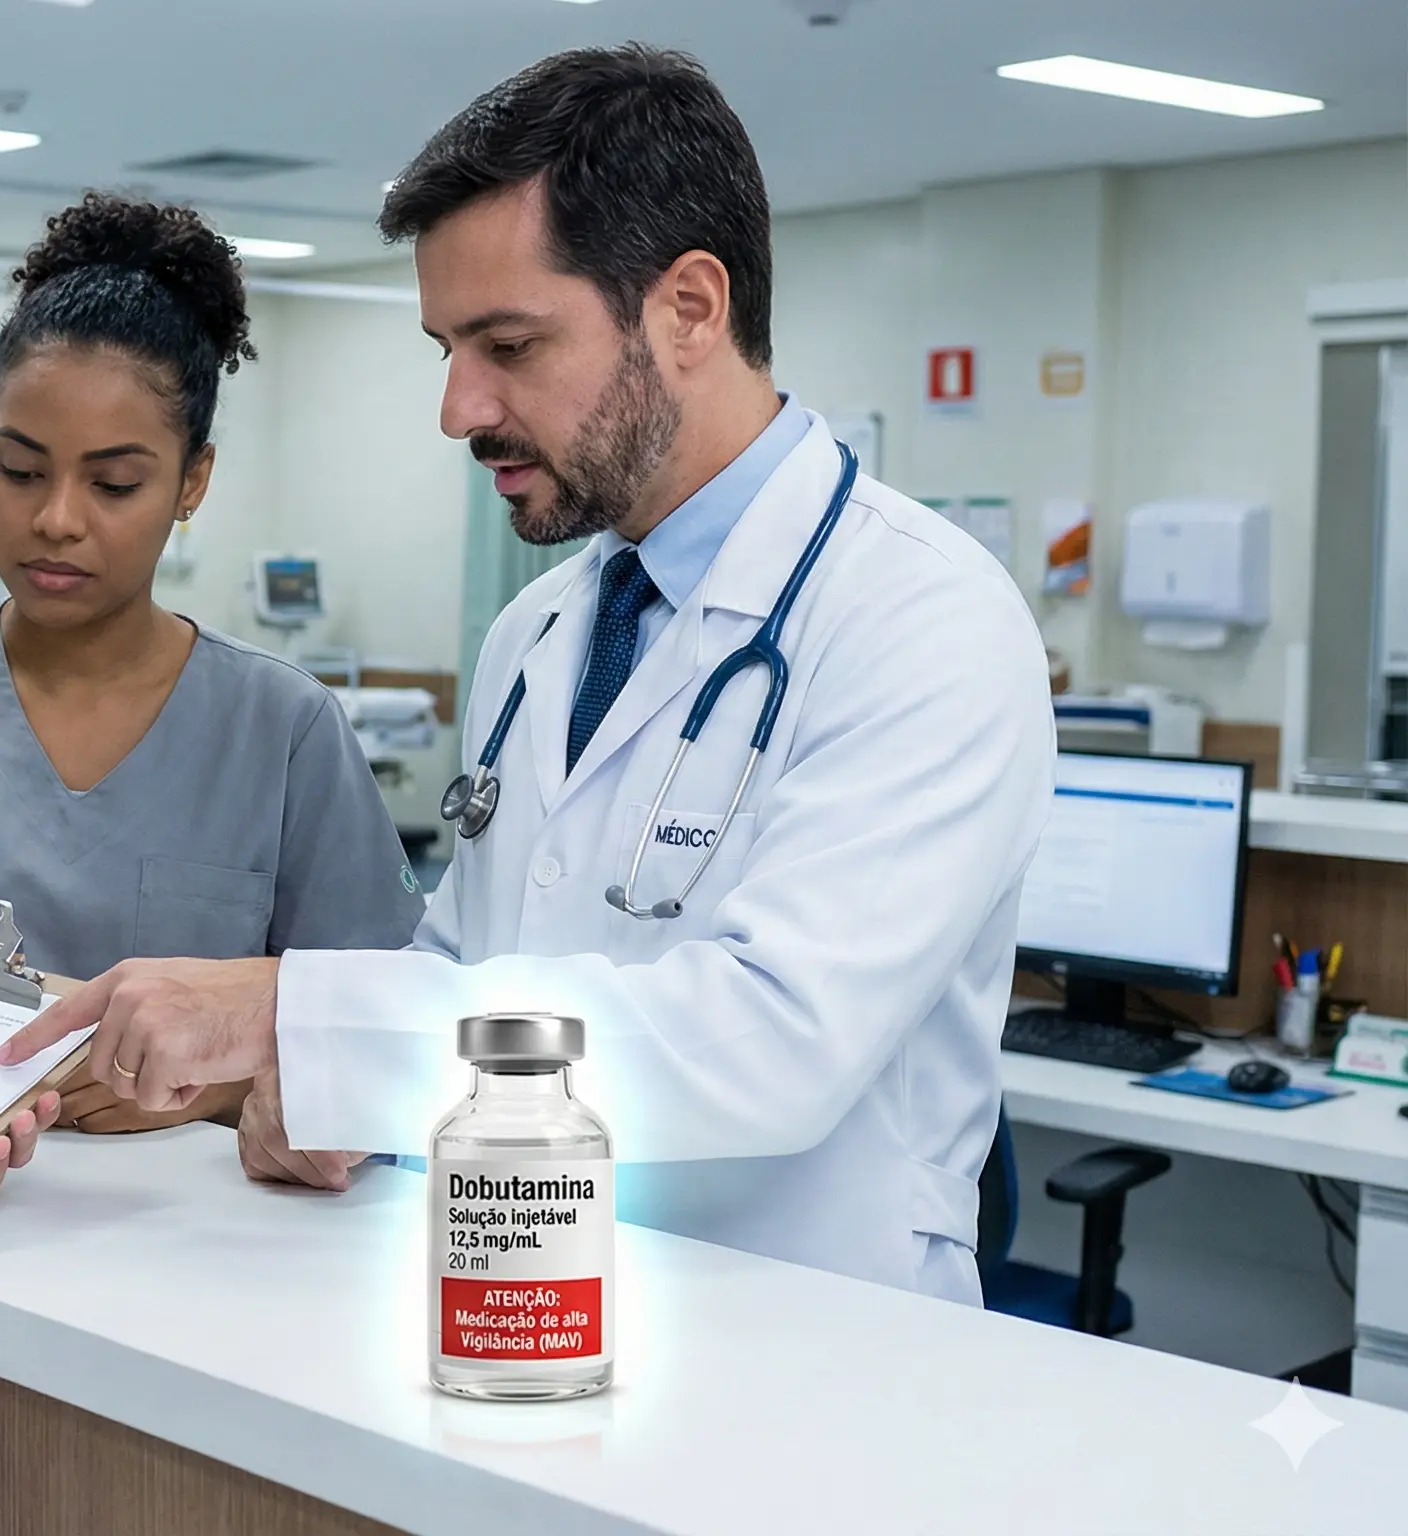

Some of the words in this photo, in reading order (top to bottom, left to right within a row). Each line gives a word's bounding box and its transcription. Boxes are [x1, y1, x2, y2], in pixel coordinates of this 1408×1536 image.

[449, 1173, 595, 1200] Dobutamina
[448, 1207, 507, 1229] Solução
[511, 1207, 577, 1229] injetável
[448, 1230, 480, 1250] 12,5
[483, 1231, 542, 1252] mg/mL
[448, 1252, 466, 1270] 20
[470, 1254, 489, 1270] ml
[483, 1287, 561, 1312] ATENÇÃO:
[455, 1309, 536, 1332] Medicação
[540, 1312, 559, 1328] de
[562, 1310, 589, 1327] alta
[460, 1331, 535, 1352] Vigilância
[539, 1331, 583, 1353] (MAV)
